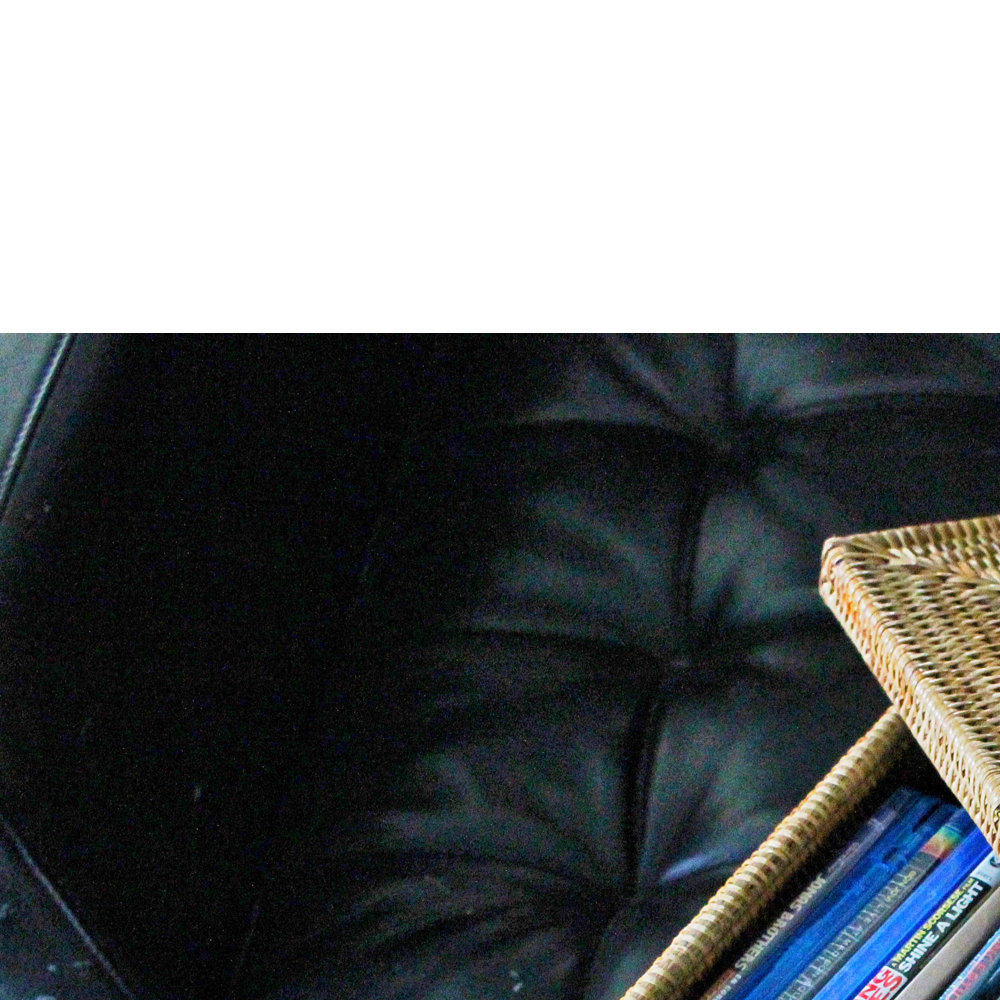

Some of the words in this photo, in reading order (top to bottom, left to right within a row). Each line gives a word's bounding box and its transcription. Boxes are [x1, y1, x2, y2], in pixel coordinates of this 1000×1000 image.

[733, 909, 794, 972] BROTHERS
[891, 927, 927, 964] MARTIN
[922, 887, 965, 932] SCORSESE
[895, 927, 941, 975] SHINE
[933, 915, 952, 934] A
[943, 878, 986, 923] LIGHT
